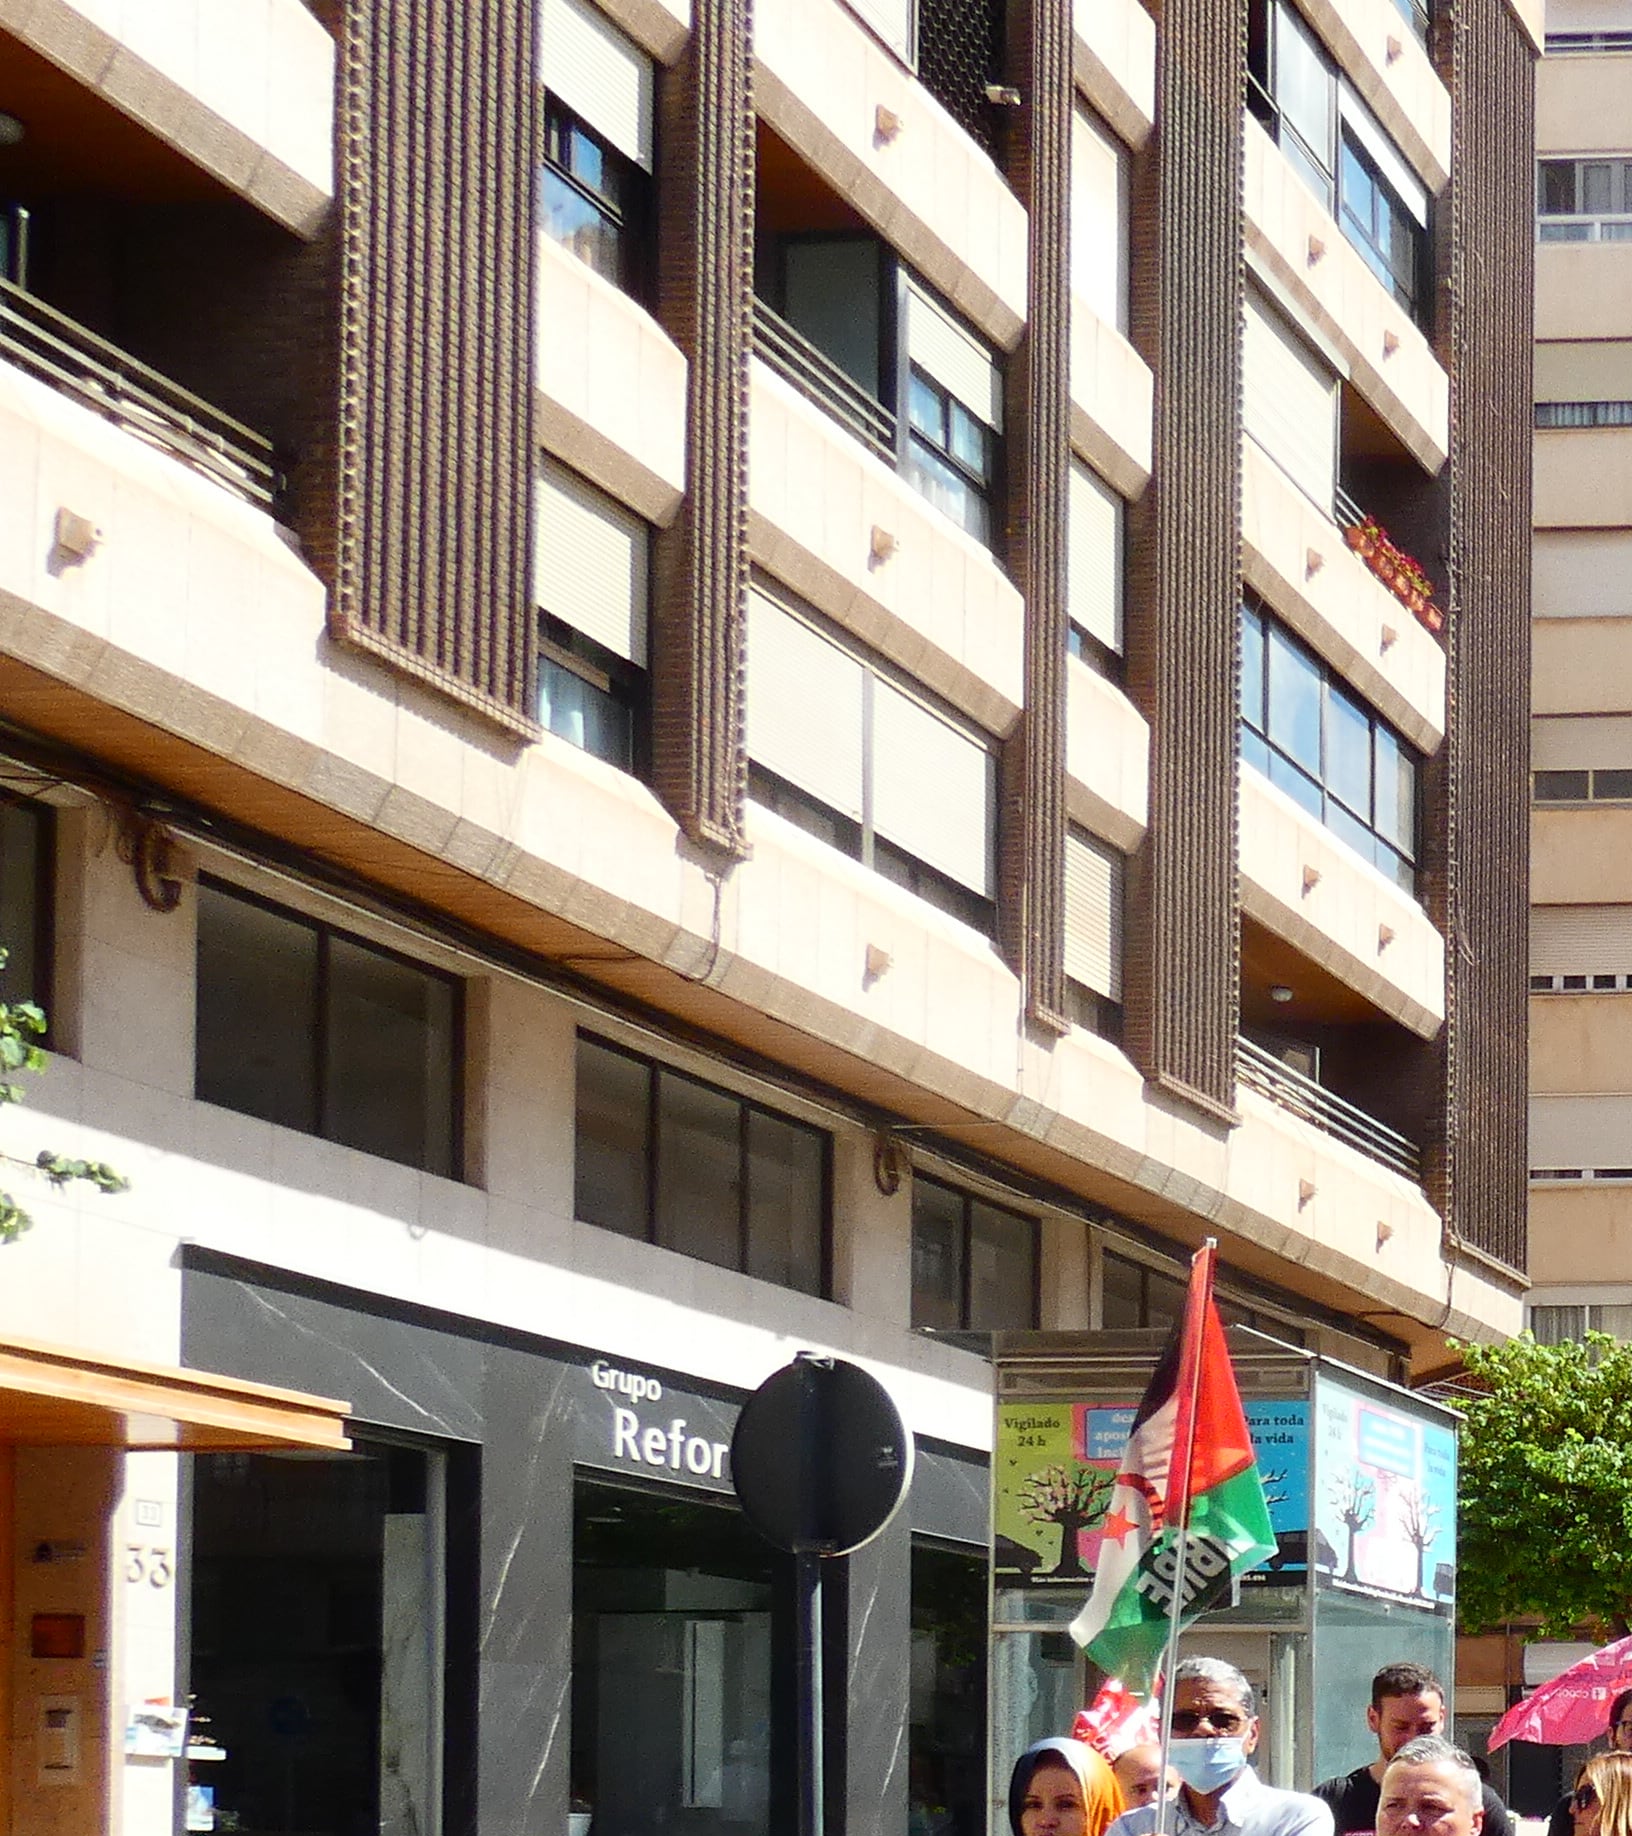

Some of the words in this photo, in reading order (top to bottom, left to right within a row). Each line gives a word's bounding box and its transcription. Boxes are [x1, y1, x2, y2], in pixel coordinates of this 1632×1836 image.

[592, 1360, 662, 1404] Grupo
[1004, 1417, 1060, 1431] Vigilado
[1273, 1414, 1305, 1426] toda
[614, 1406, 729, 1478] Refor
[1016, 1435, 1035, 1447] 24
[1037, 1435, 1046, 1447] h
[1250, 1433, 1262, 1444] la
[1265, 1432, 1294, 1444] vida
[127, 1546, 171, 1588] 33
